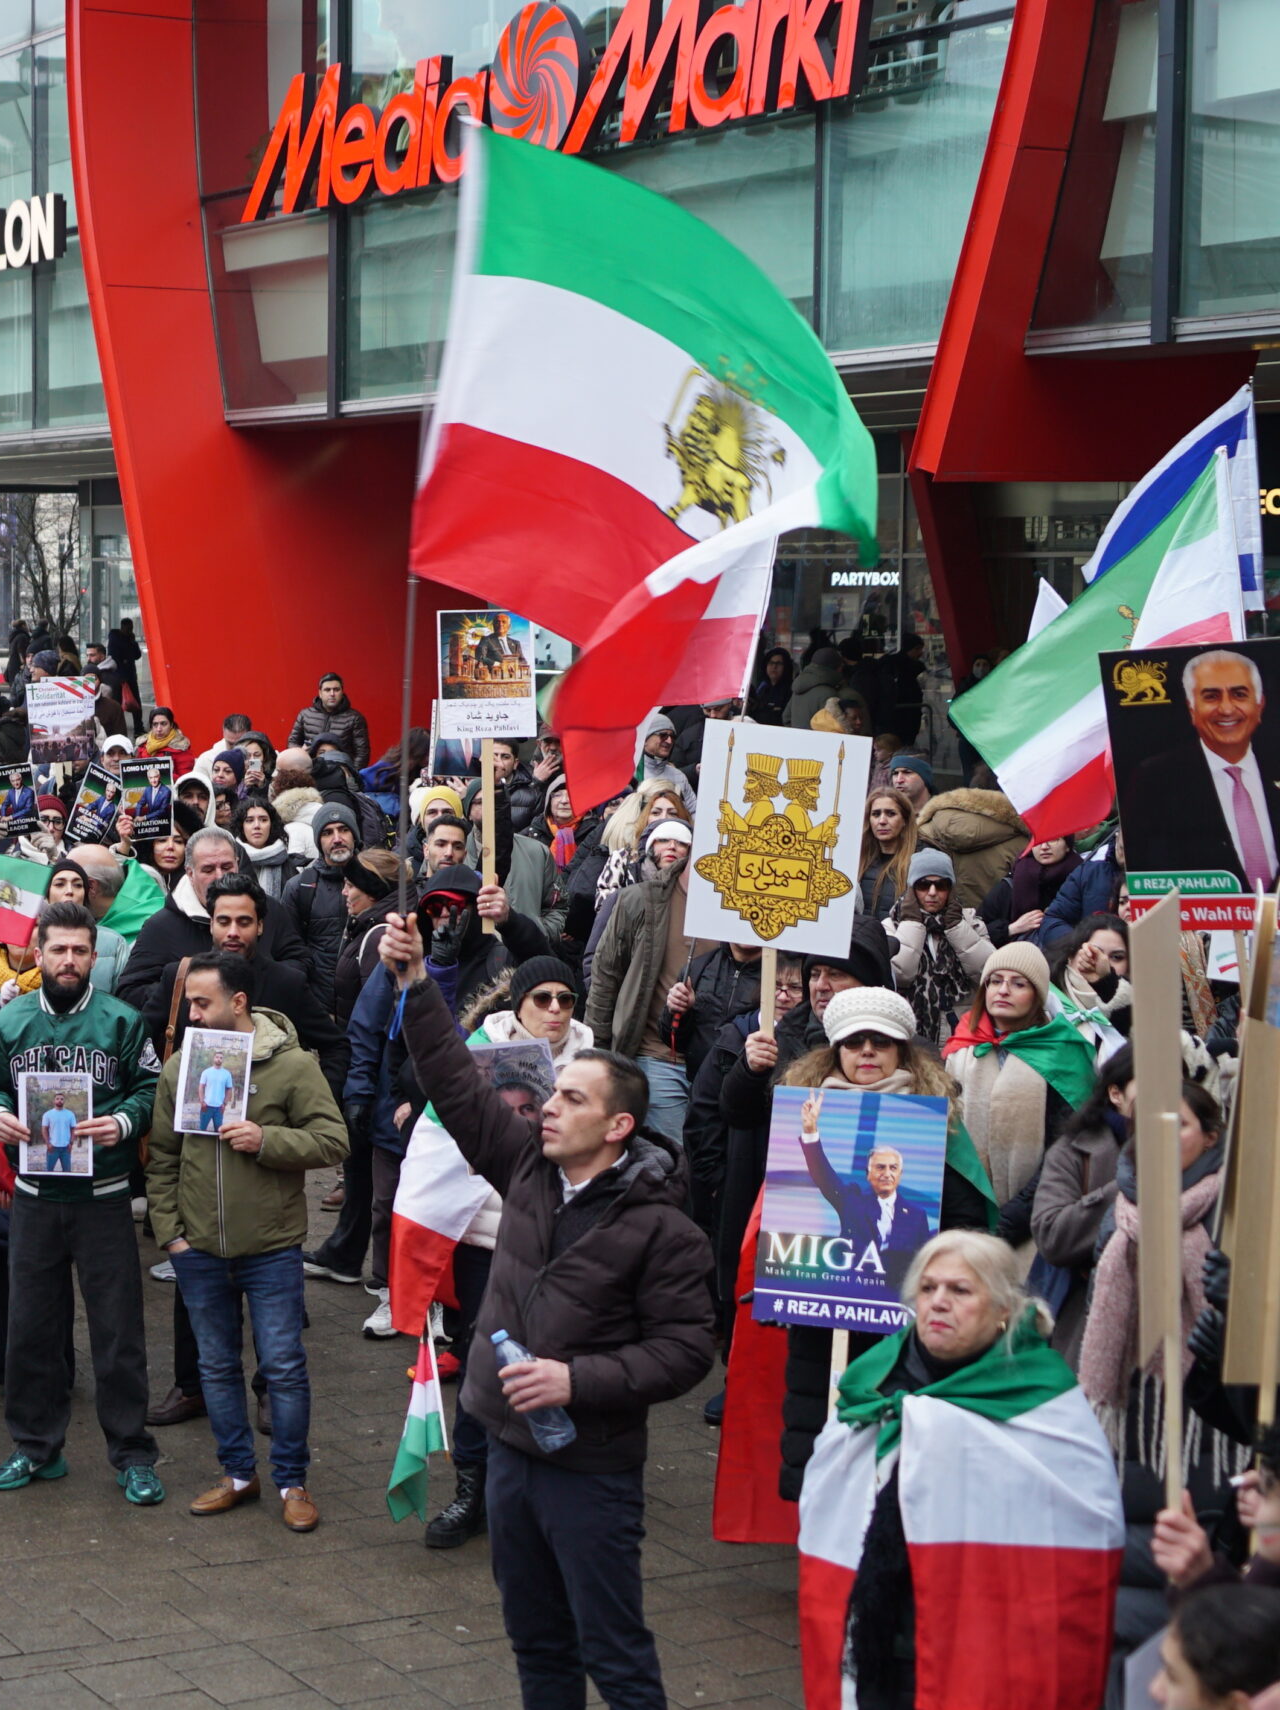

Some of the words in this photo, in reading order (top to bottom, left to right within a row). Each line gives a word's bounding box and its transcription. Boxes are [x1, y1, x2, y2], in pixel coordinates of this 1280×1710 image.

[240, 54, 490, 223] Media
[563, 0, 862, 154] Markt
[831, 571, 900, 587] PARTYBOX
[35, 691, 66, 700] Solidarität
[466, 711, 482, 720] شاه
[486, 711, 509, 722] جاوید
[493, 724, 520, 732] Pahlavi
[8, 816, 37, 825] NATIONAL
[141, 818, 169, 827] NATIONAL
[137, 826, 160, 834] LEADER
[738, 858, 810, 882] همکاری
[753, 874, 790, 891] ملی
[1143, 878, 1175, 890] REZA
[1177, 876, 1232, 890] PAHLAVI
[1191, 906, 1232, 921] Wahl
[9, 1044, 118, 1090] CHICAGO
[765, 1231, 887, 1275] MIGA
[765, 1265, 791, 1277] Make
[796, 1268, 817, 1280] Iran
[821, 1271, 851, 1283] Great
[854, 1275, 886, 1287] Again
[773, 1298, 784, 1312] #
[786, 1299, 831, 1318] REZA
[834, 1303, 908, 1327] PAHLAVI
